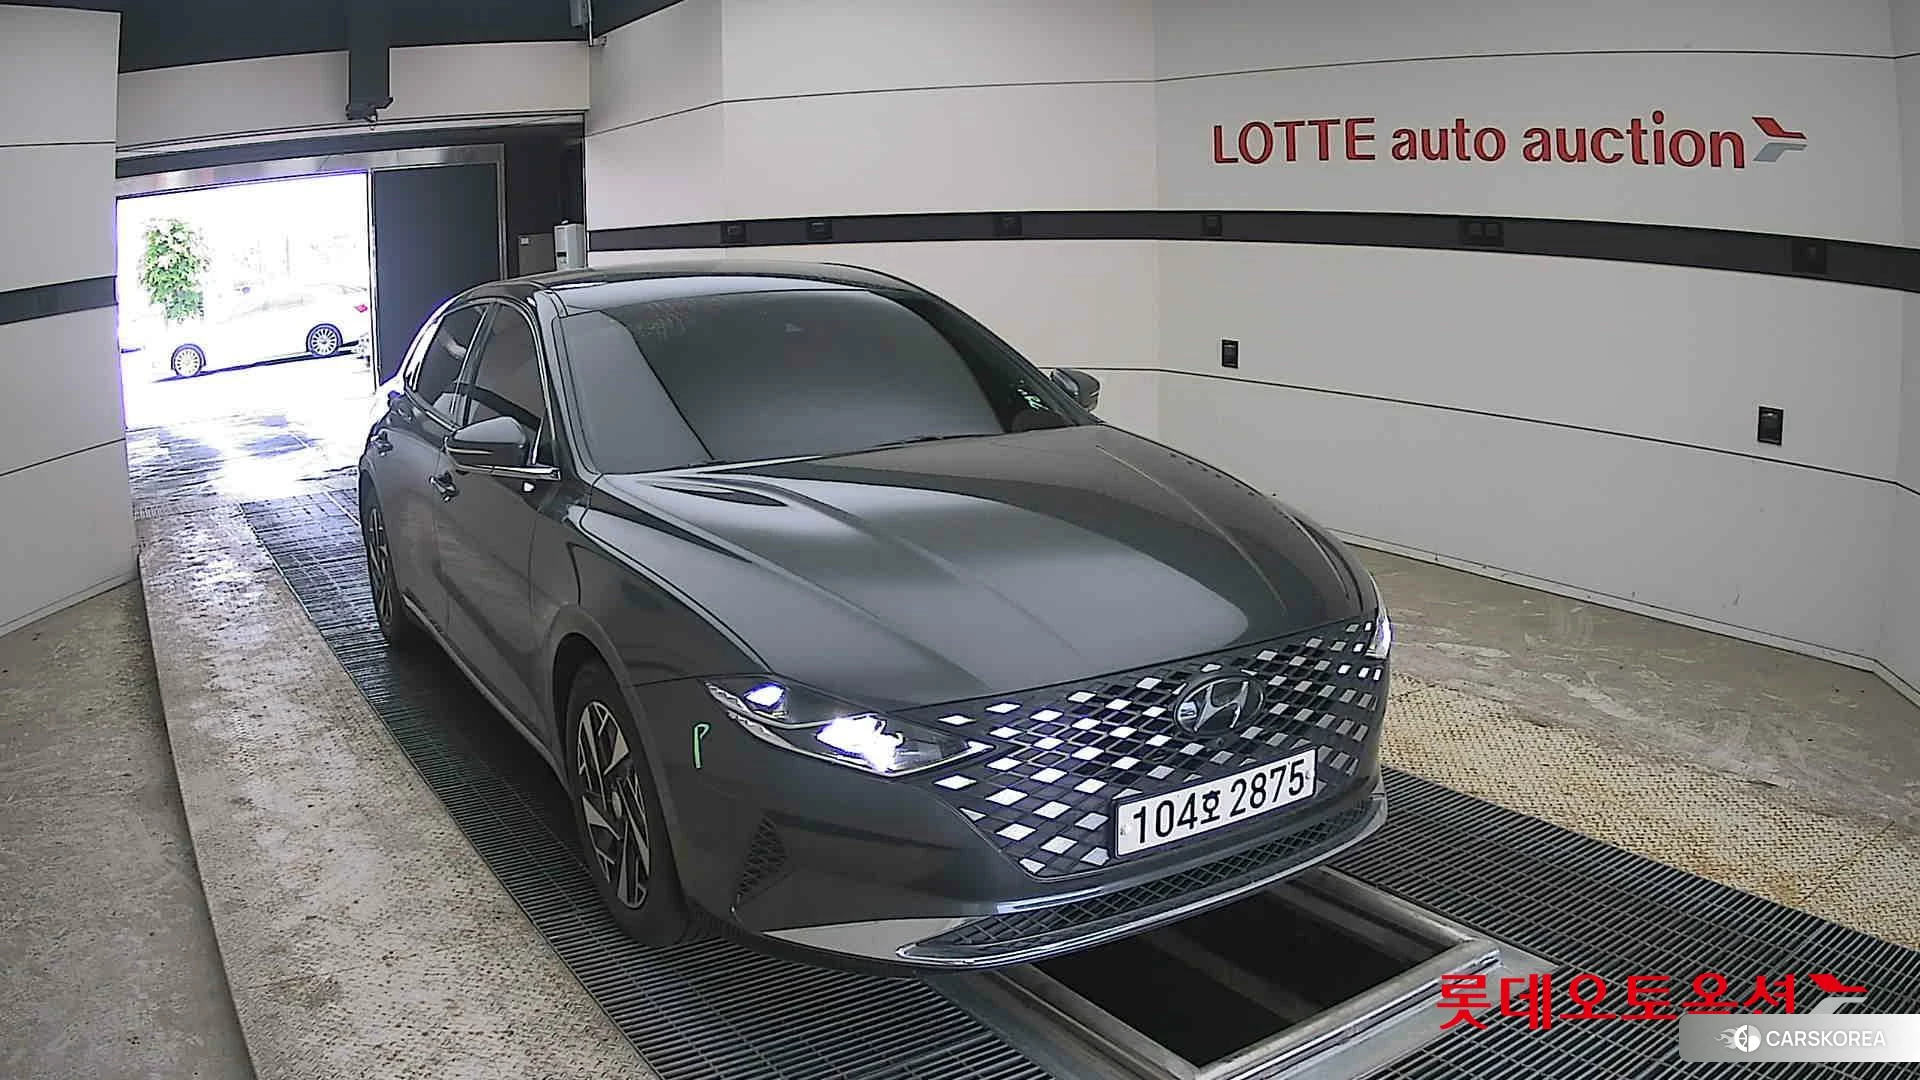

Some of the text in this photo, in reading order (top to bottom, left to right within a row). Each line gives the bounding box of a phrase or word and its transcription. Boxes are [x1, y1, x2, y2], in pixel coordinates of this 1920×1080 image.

[1213, 110, 1745, 169] LOTTE auto auction
[1133, 760, 1305, 844] 104호 2875
